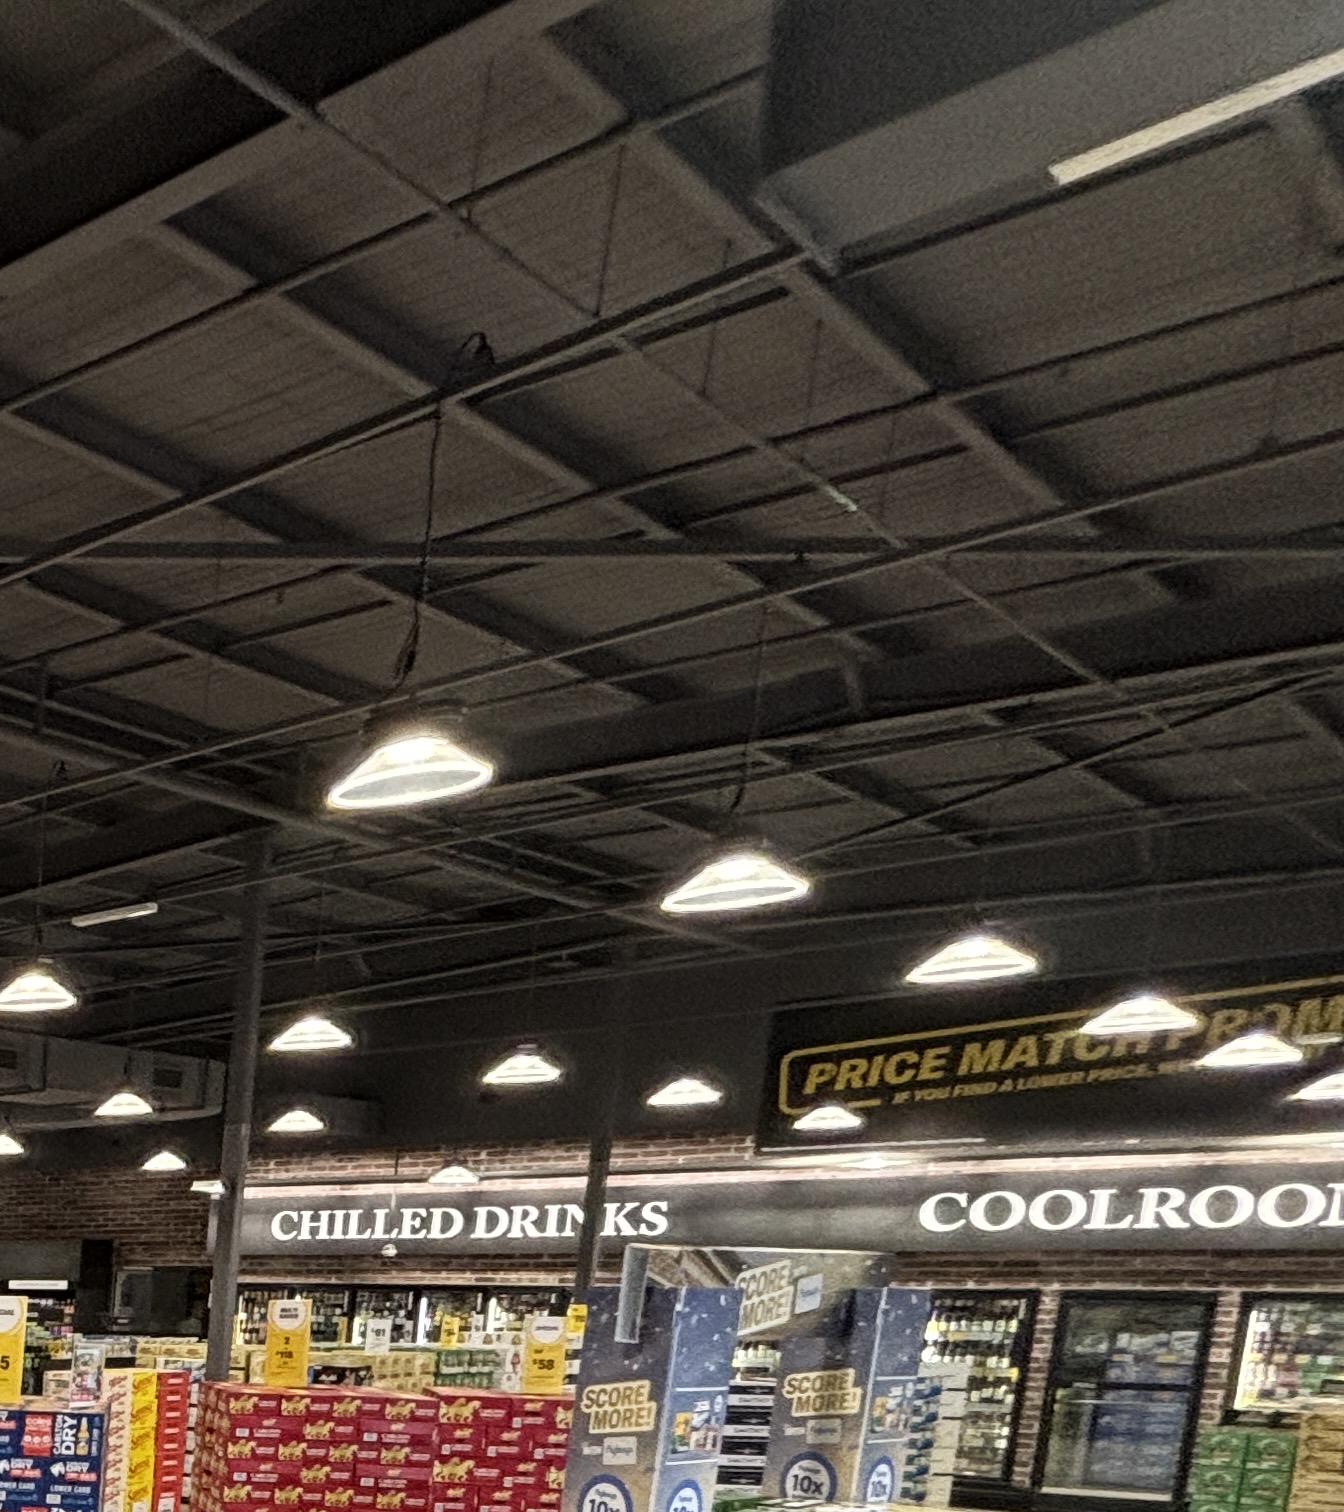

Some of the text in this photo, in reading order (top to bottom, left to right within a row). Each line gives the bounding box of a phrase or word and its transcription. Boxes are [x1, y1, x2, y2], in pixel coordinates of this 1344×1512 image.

[802, 1046, 952, 1095] PRICE
[270, 1200, 670, 1242] CHILLED DRINKS
[786, 1373, 849, 1394] SCORE
[584, 1384, 648, 1410] SCORE
[796, 1392, 857, 1413] MORE!
[592, 1405, 653, 1430] MORE!
[53, 1415, 64, 1454] CARLTON
[61, 1415, 78, 1455] DRY
[793, 1474, 824, 1496] 10x
